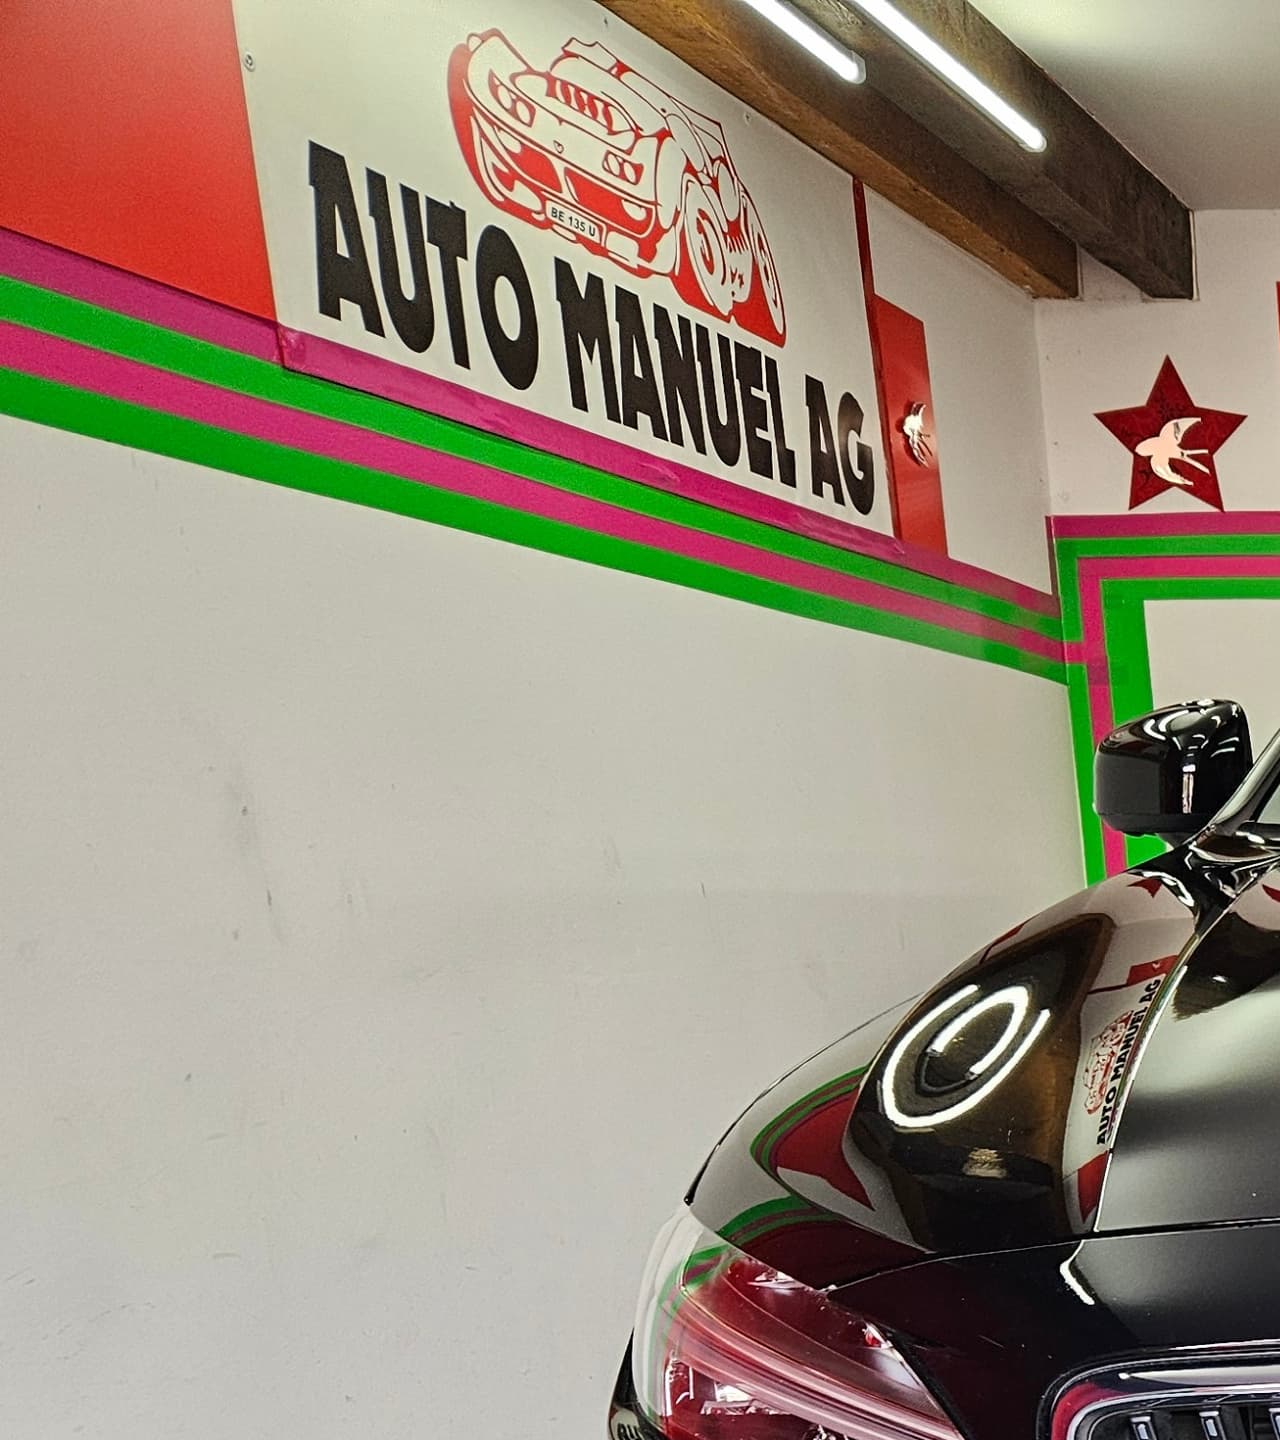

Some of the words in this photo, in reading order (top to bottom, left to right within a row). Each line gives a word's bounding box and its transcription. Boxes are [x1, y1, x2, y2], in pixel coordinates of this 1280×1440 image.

[551, 206, 565, 223] BE
[568, 215, 586, 232] 135
[589, 225, 596, 237] U
[308, 140, 539, 390] AUTO
[555, 256, 796, 488] MANUEL
[804, 374, 875, 516] AG
[1096, 1086, 1117, 1145] AUTO
[1111, 1006, 1147, 1082] MANUEL
[1139, 978, 1161, 1004] AG
